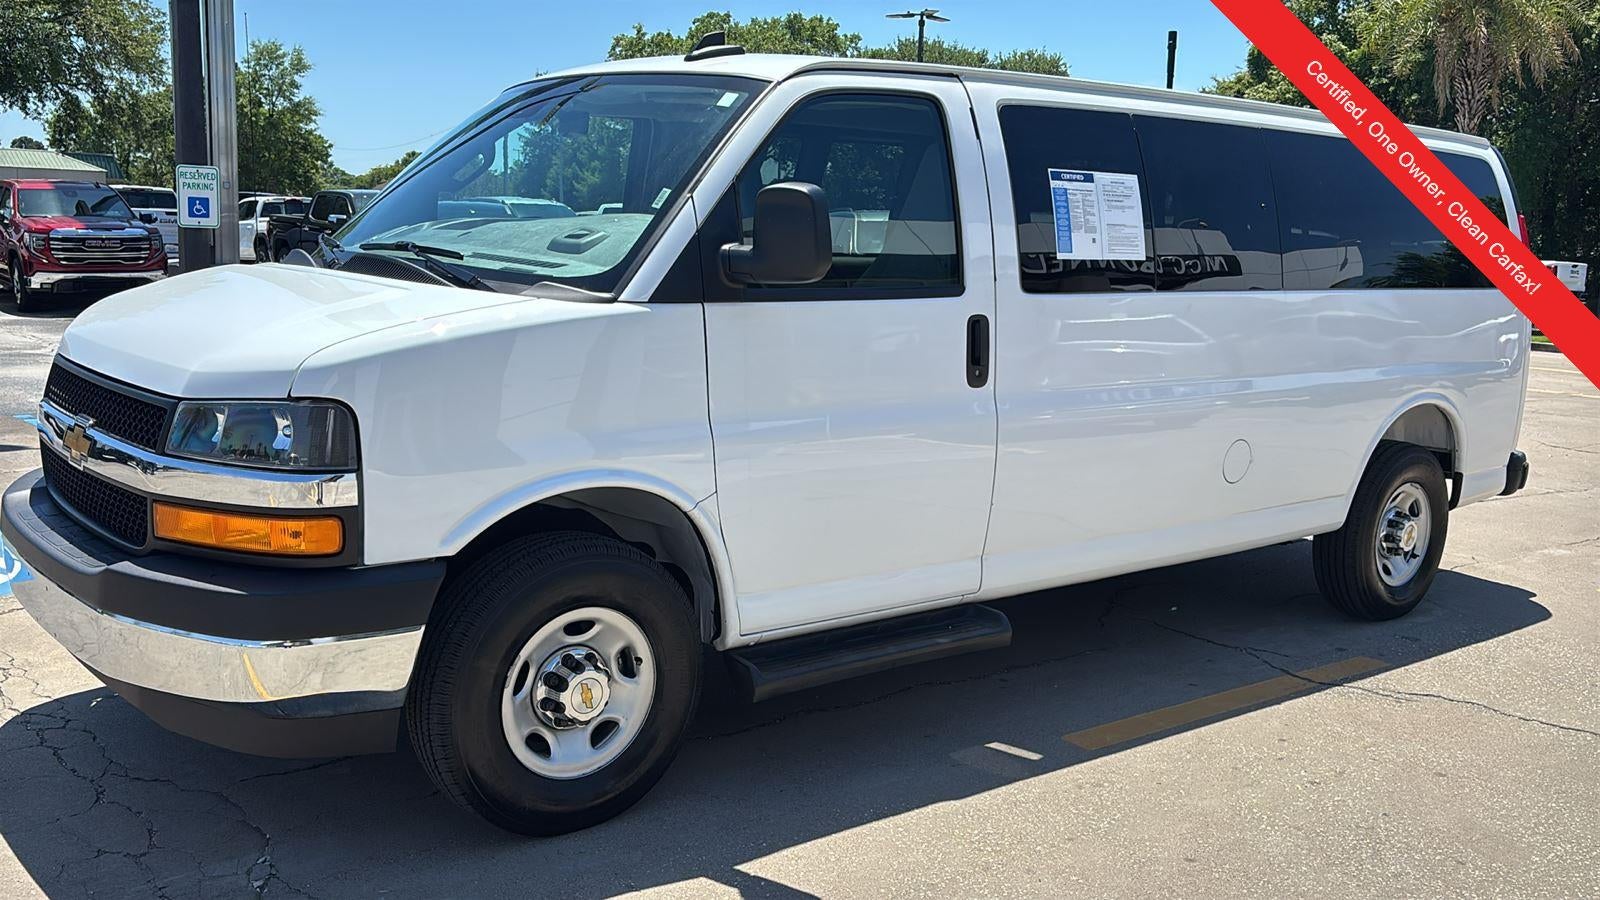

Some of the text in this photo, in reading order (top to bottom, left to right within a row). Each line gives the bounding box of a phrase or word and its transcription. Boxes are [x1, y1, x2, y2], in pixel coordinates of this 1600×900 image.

[180, 171, 216, 181] RESERVED
[1060, 173, 1085, 181] CERTIFIED
[182, 182, 214, 191] PARKING
